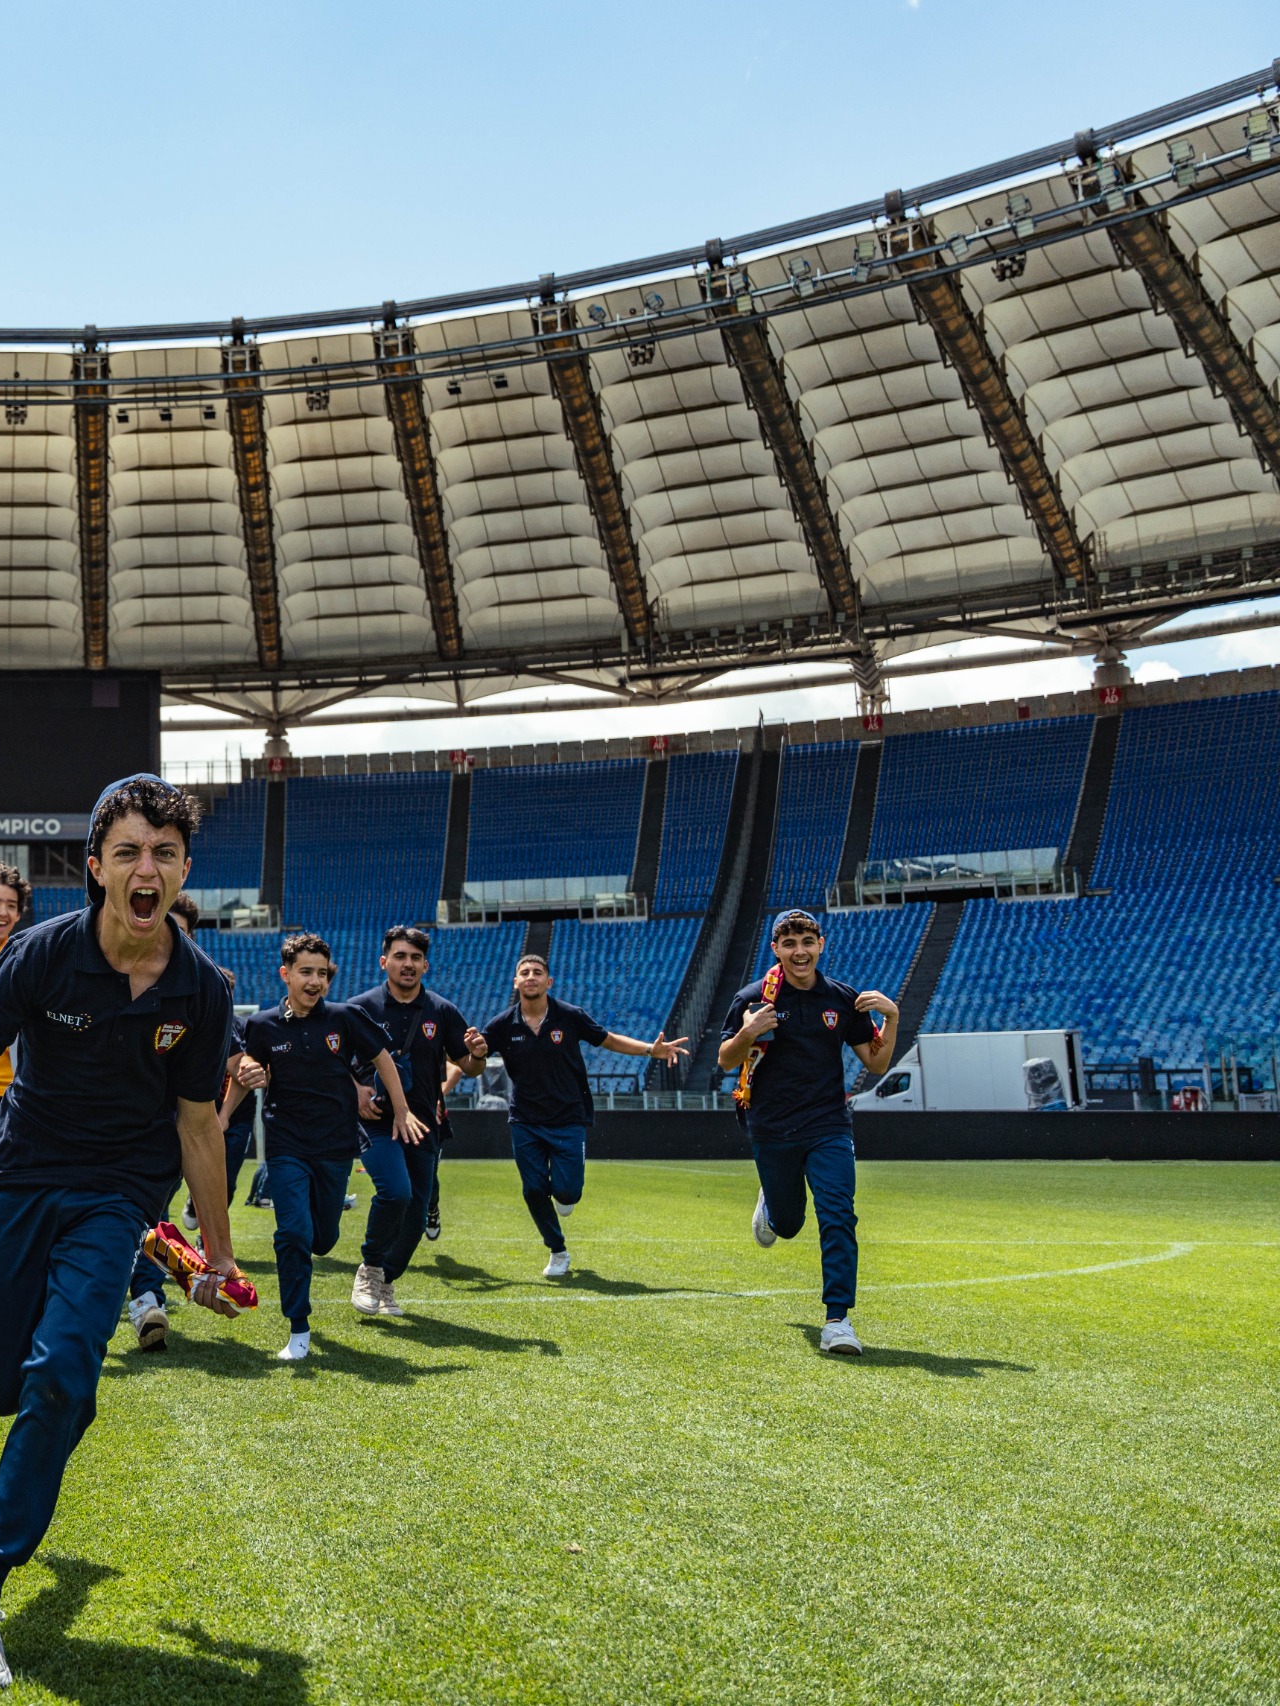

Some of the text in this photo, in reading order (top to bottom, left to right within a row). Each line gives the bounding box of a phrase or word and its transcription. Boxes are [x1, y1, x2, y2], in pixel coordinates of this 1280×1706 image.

[1105, 687, 1116, 695] 17
[1104, 695, 1119, 704] AD
[46, 1010, 84, 1026] ELNET
